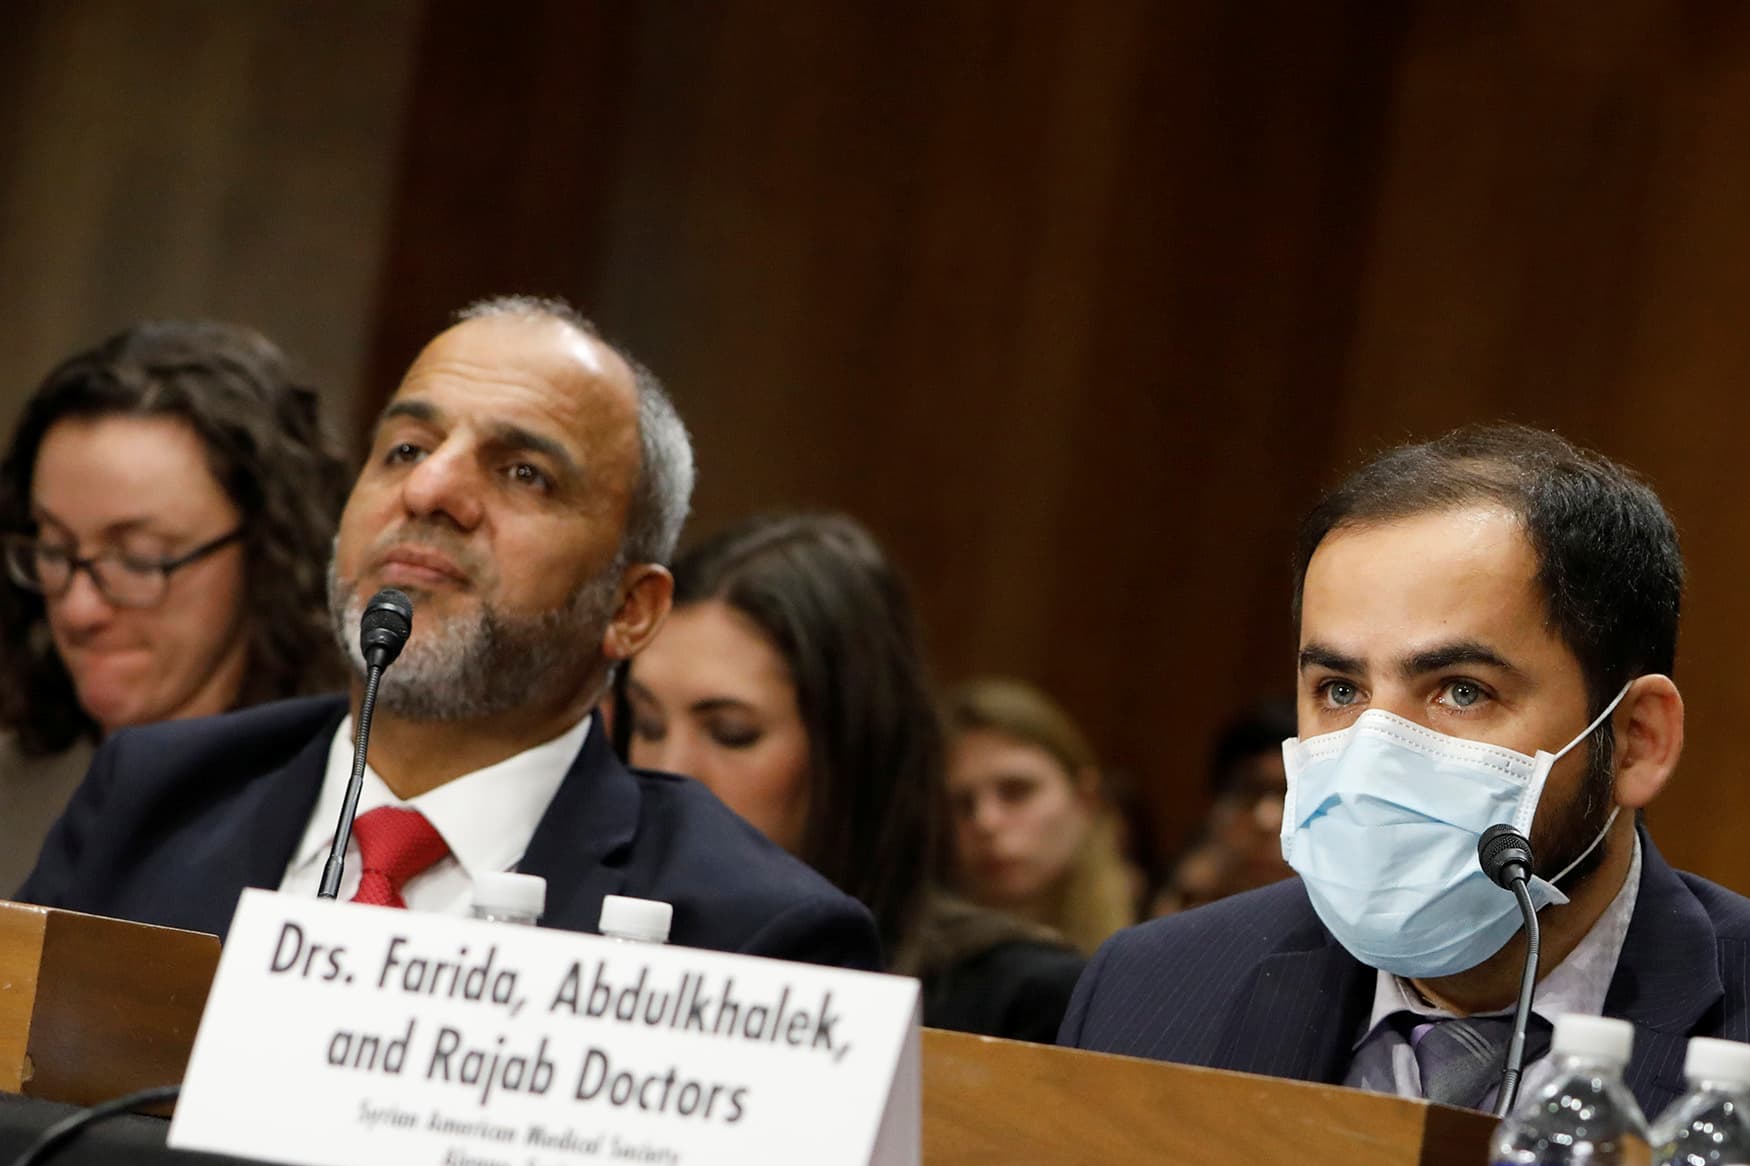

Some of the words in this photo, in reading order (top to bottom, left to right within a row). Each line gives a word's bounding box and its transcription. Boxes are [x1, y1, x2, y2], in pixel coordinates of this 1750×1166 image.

[269, 921, 353, 984] Drs.
[378, 936, 526, 1017] Farida,
[549, 960, 850, 1062] Abdulkhalek,
[327, 1018, 416, 1075] and
[426, 1026, 555, 1107] Rajab
[574, 1047, 748, 1124] Doctors
